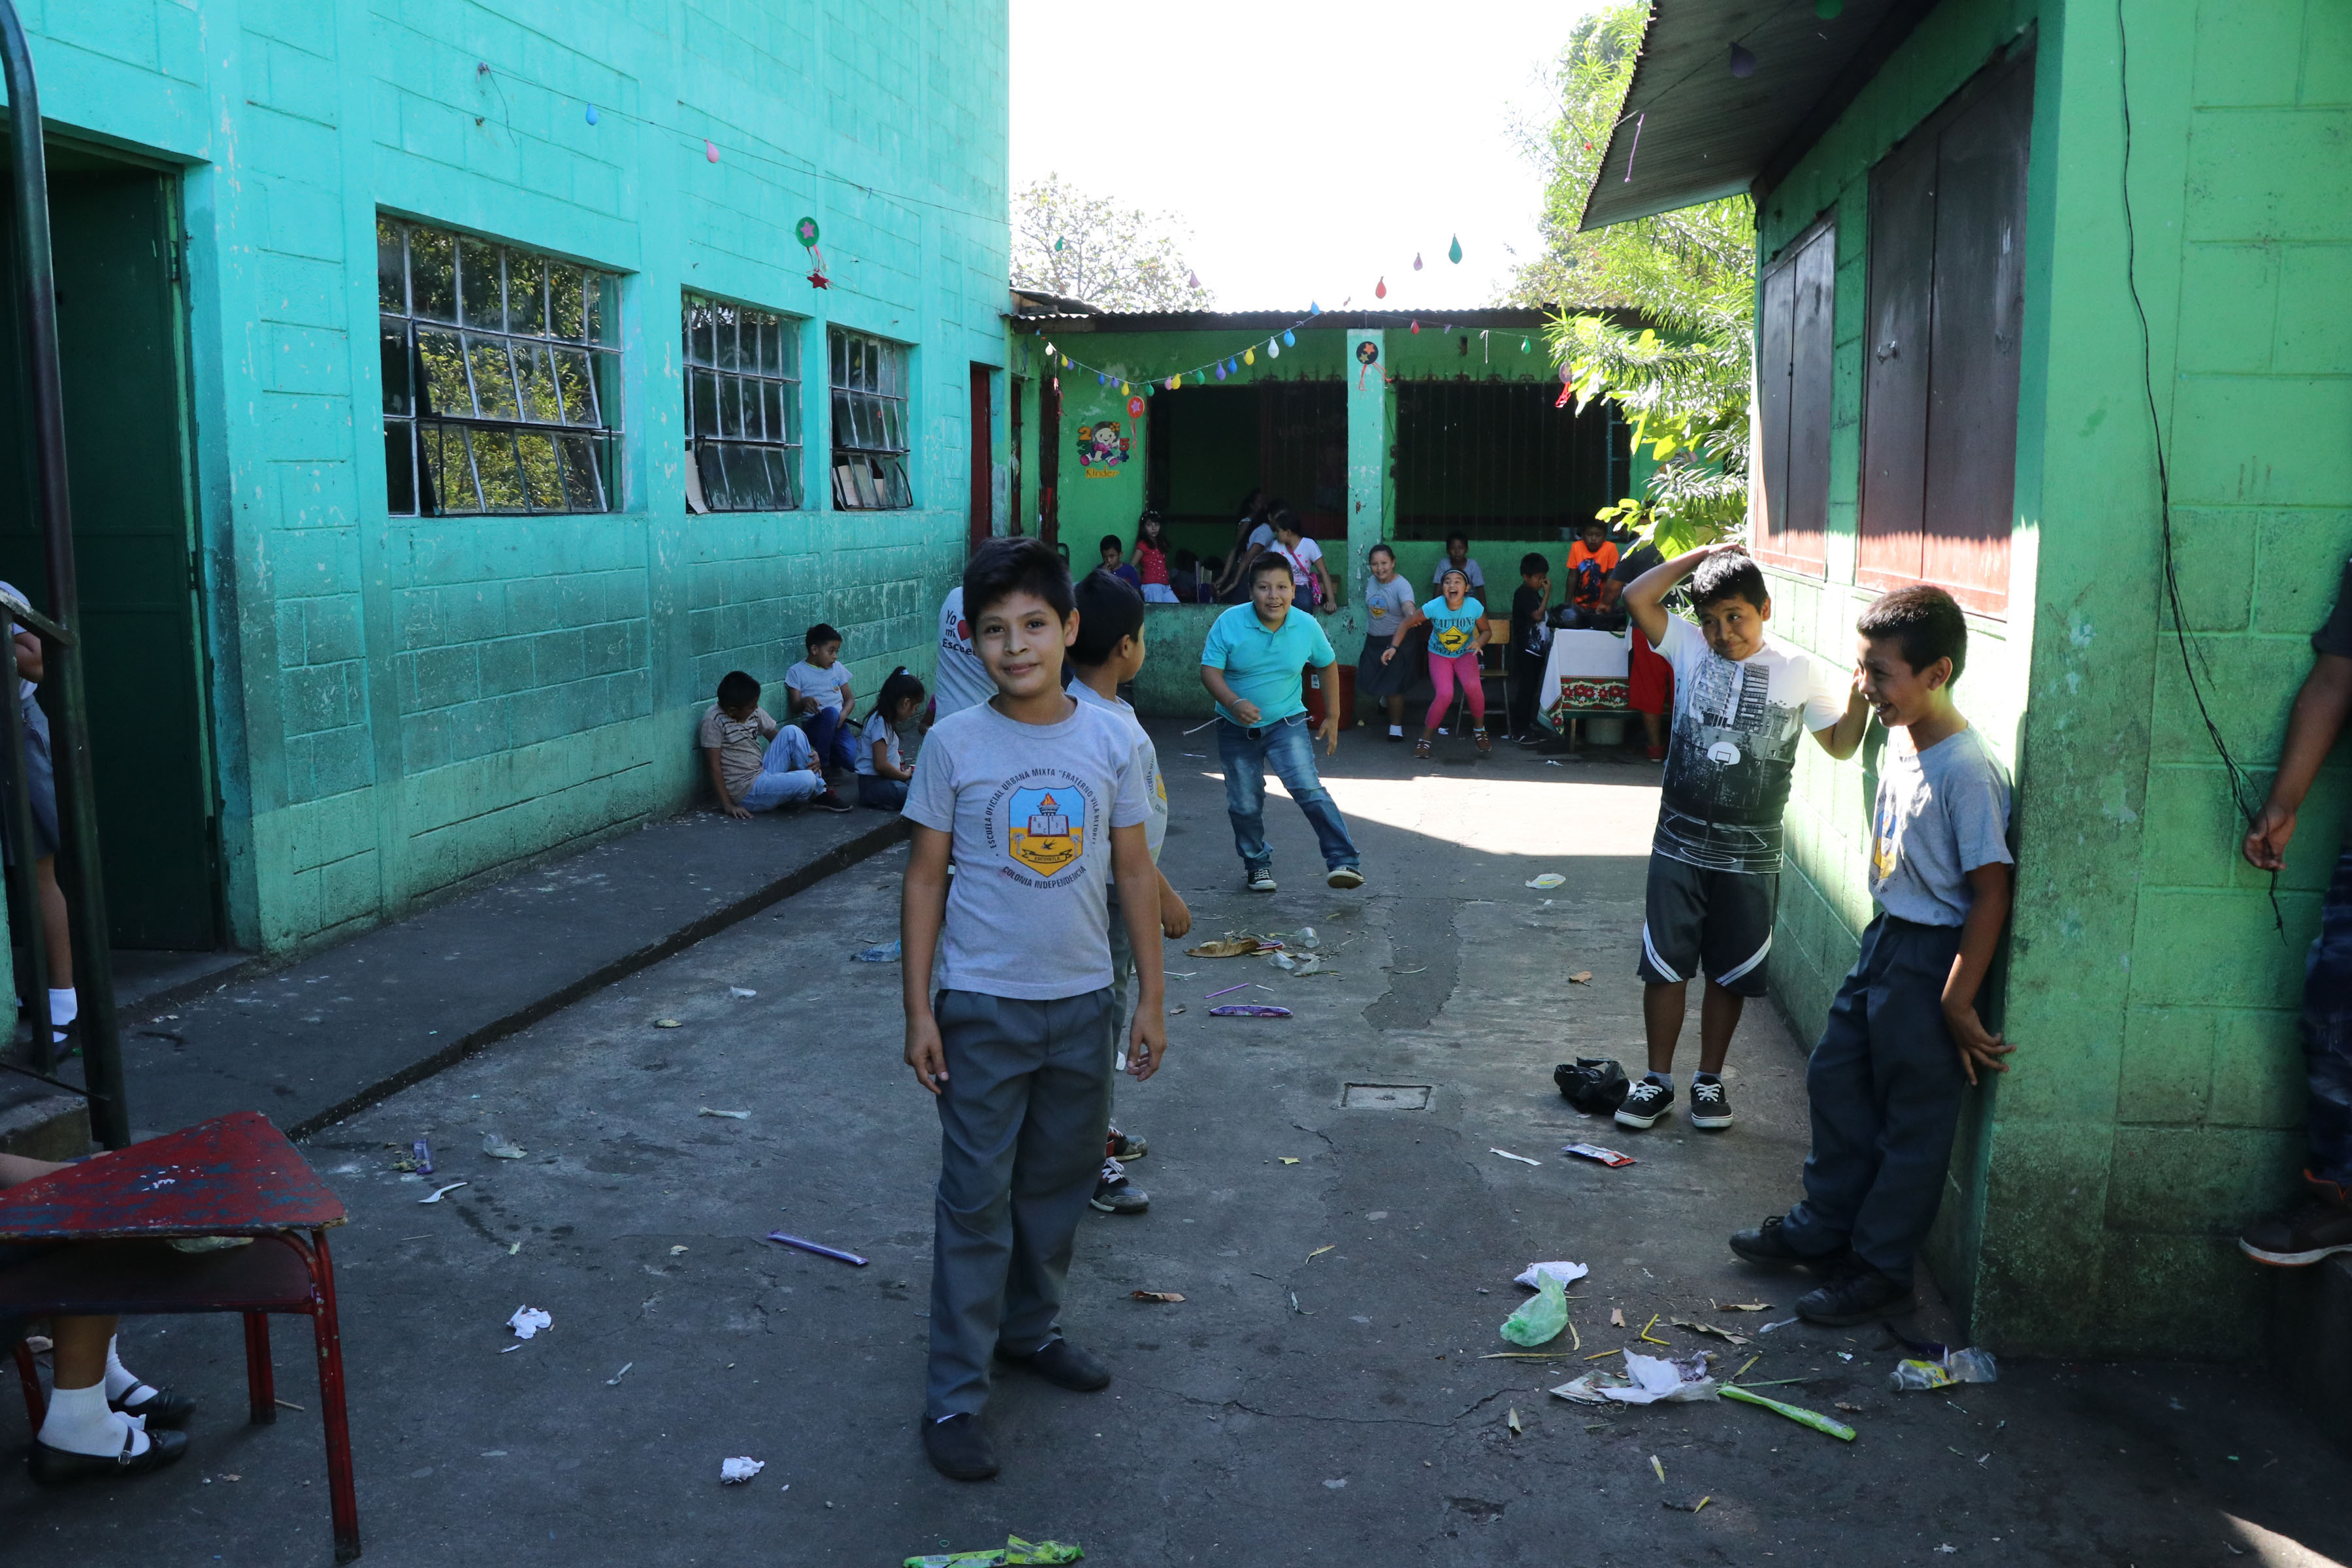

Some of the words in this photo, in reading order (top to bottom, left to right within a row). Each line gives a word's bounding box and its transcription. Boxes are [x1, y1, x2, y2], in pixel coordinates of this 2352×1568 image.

[945, 610, 957, 625] Yo
[1002, 771, 1030, 791] URBANA
[1032, 768, 1055, 777] MIXTA
[985, 790, 1004, 816] OFICIAL
[1091, 796, 1100, 813] VILA
[985, 818, 996, 849] ESCUELA
[1003, 866, 1032, 887] COLONIA
[1034, 866, 1086, 889] INDEPENDENCIA
